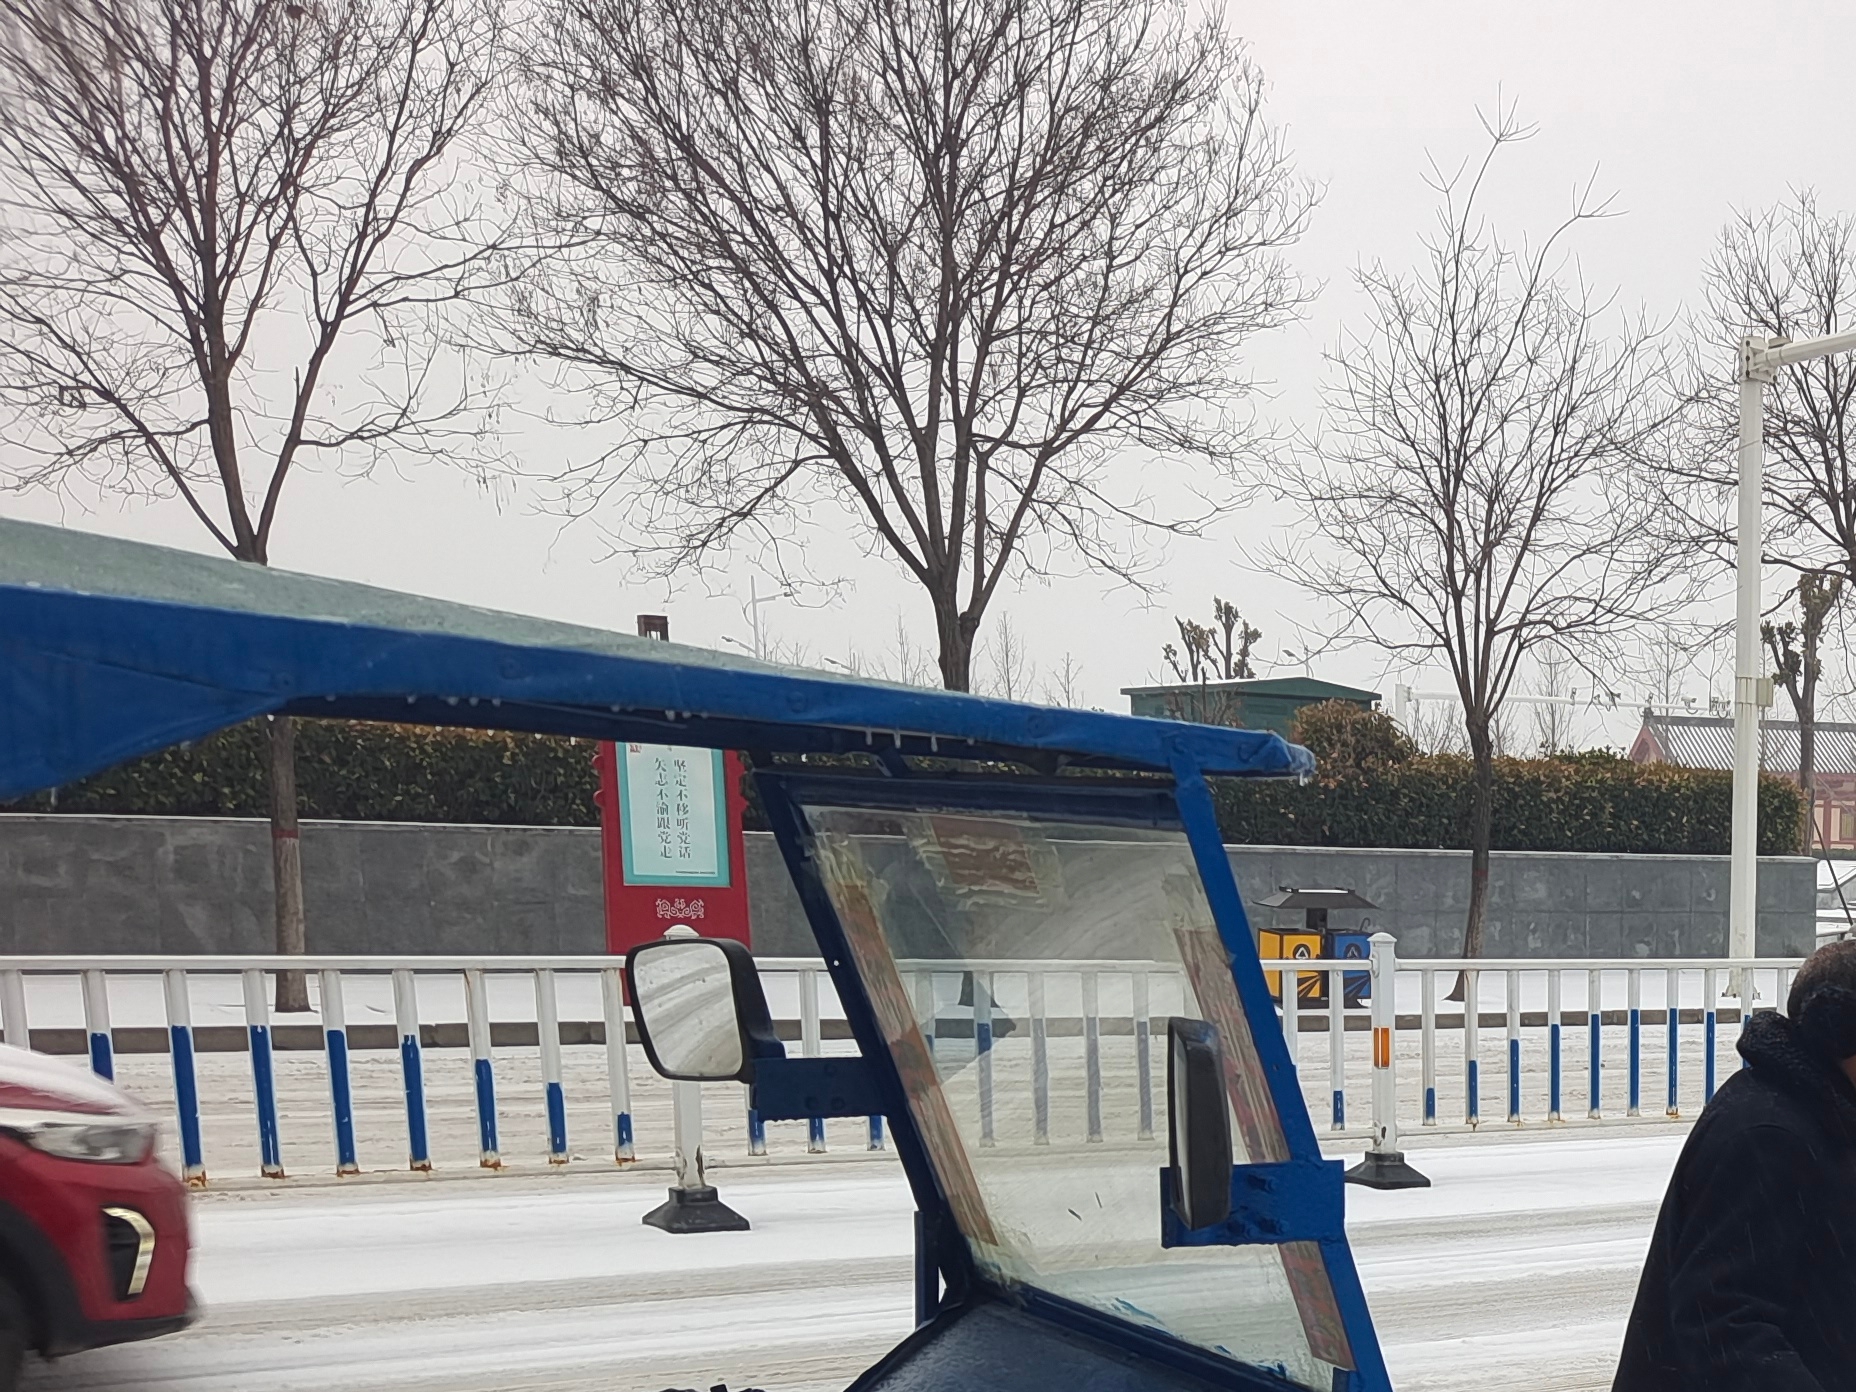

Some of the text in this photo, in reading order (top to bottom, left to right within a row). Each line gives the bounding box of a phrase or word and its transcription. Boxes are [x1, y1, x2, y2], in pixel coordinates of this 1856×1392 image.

[654, 757, 673, 859] 矢志不渝跟党走
[673, 758, 691, 859] 坚定不移听党话
